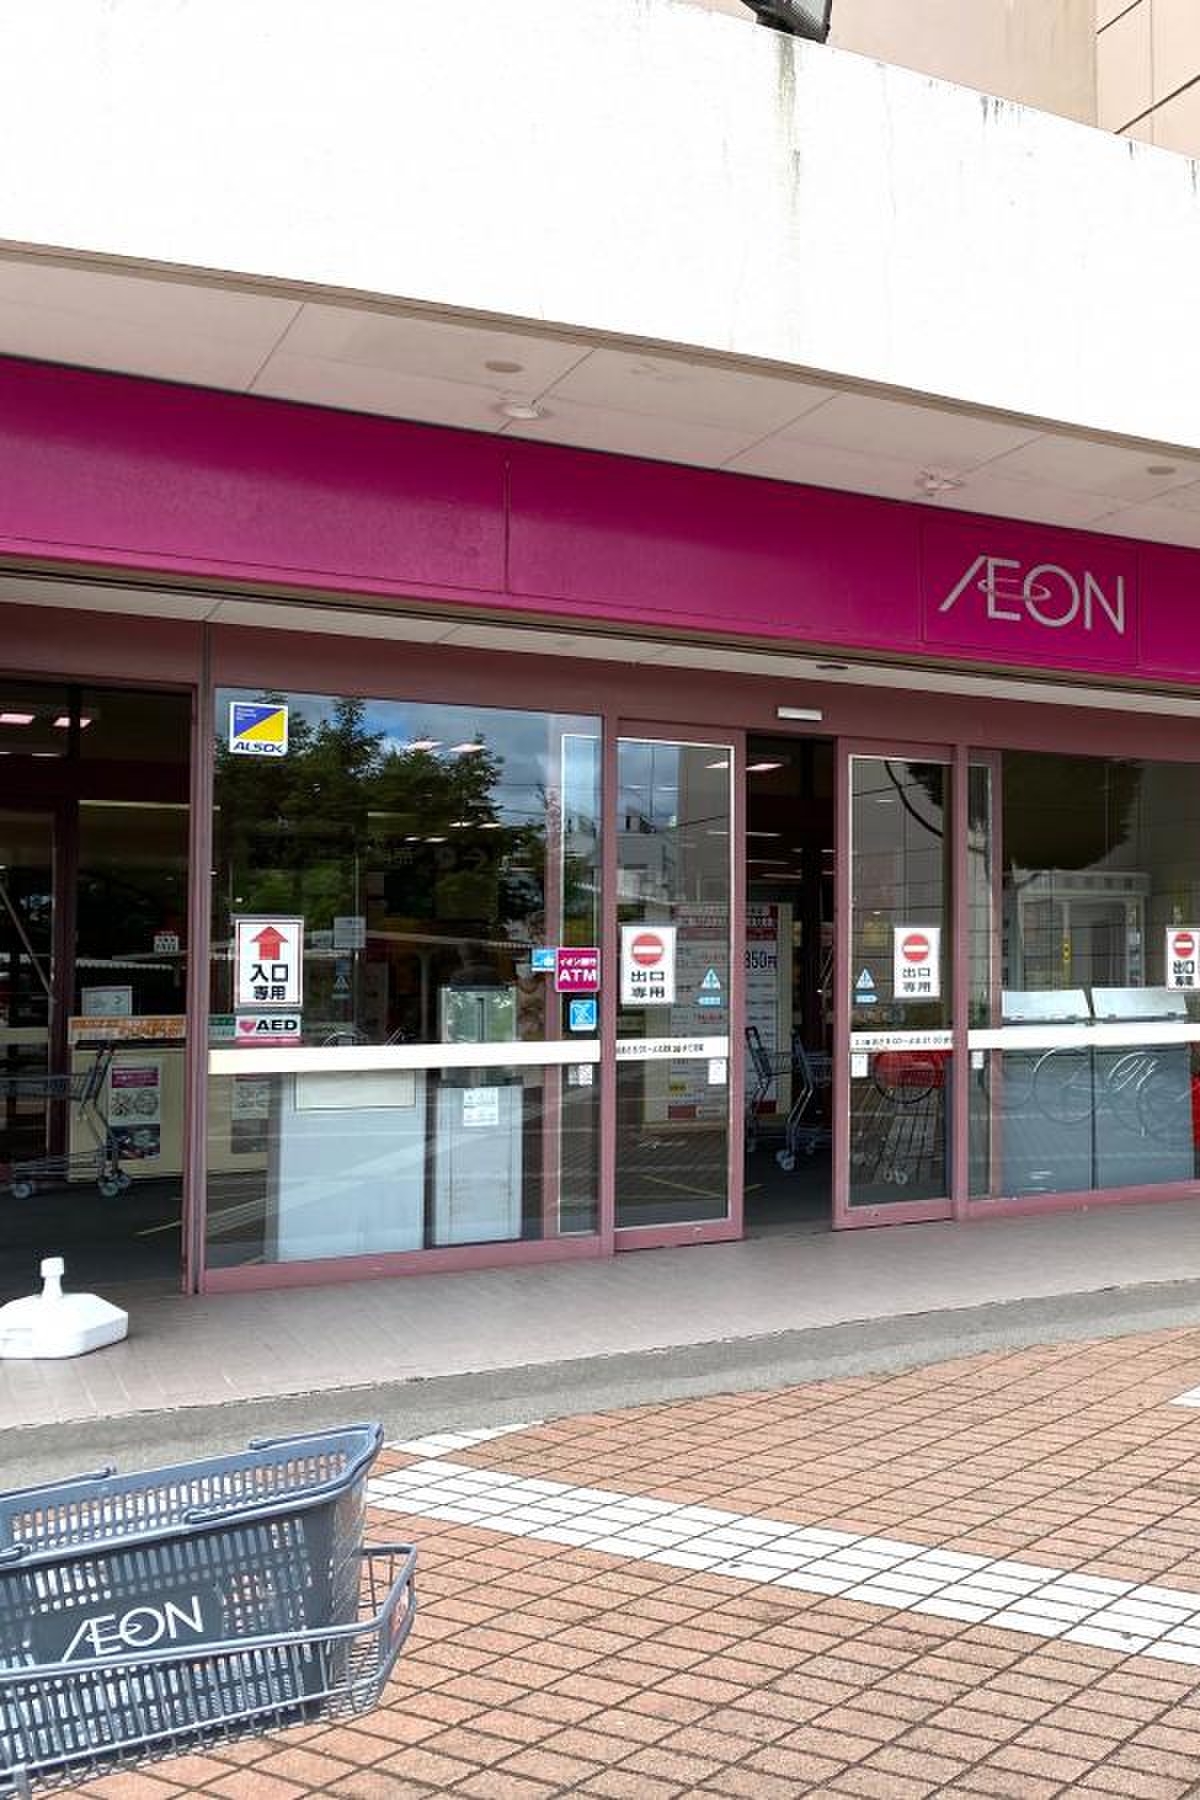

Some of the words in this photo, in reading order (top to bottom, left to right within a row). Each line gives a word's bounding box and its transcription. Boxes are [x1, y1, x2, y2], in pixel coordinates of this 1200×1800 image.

[938, 553, 1125, 635] AEON
[250, 963, 289, 983] 入口
[902, 967, 931, 979] 出口
[1173, 960, 1195, 975] 出口
[560, 968, 597, 982] ATM
[631, 970, 665, 983] 出口
[253, 985, 286, 1000] 専用
[631, 985, 665, 998] 専用
[902, 981, 931, 993] 専用
[256, 1019, 298, 1031] AED
[62, 1595, 204, 1664] AEON
